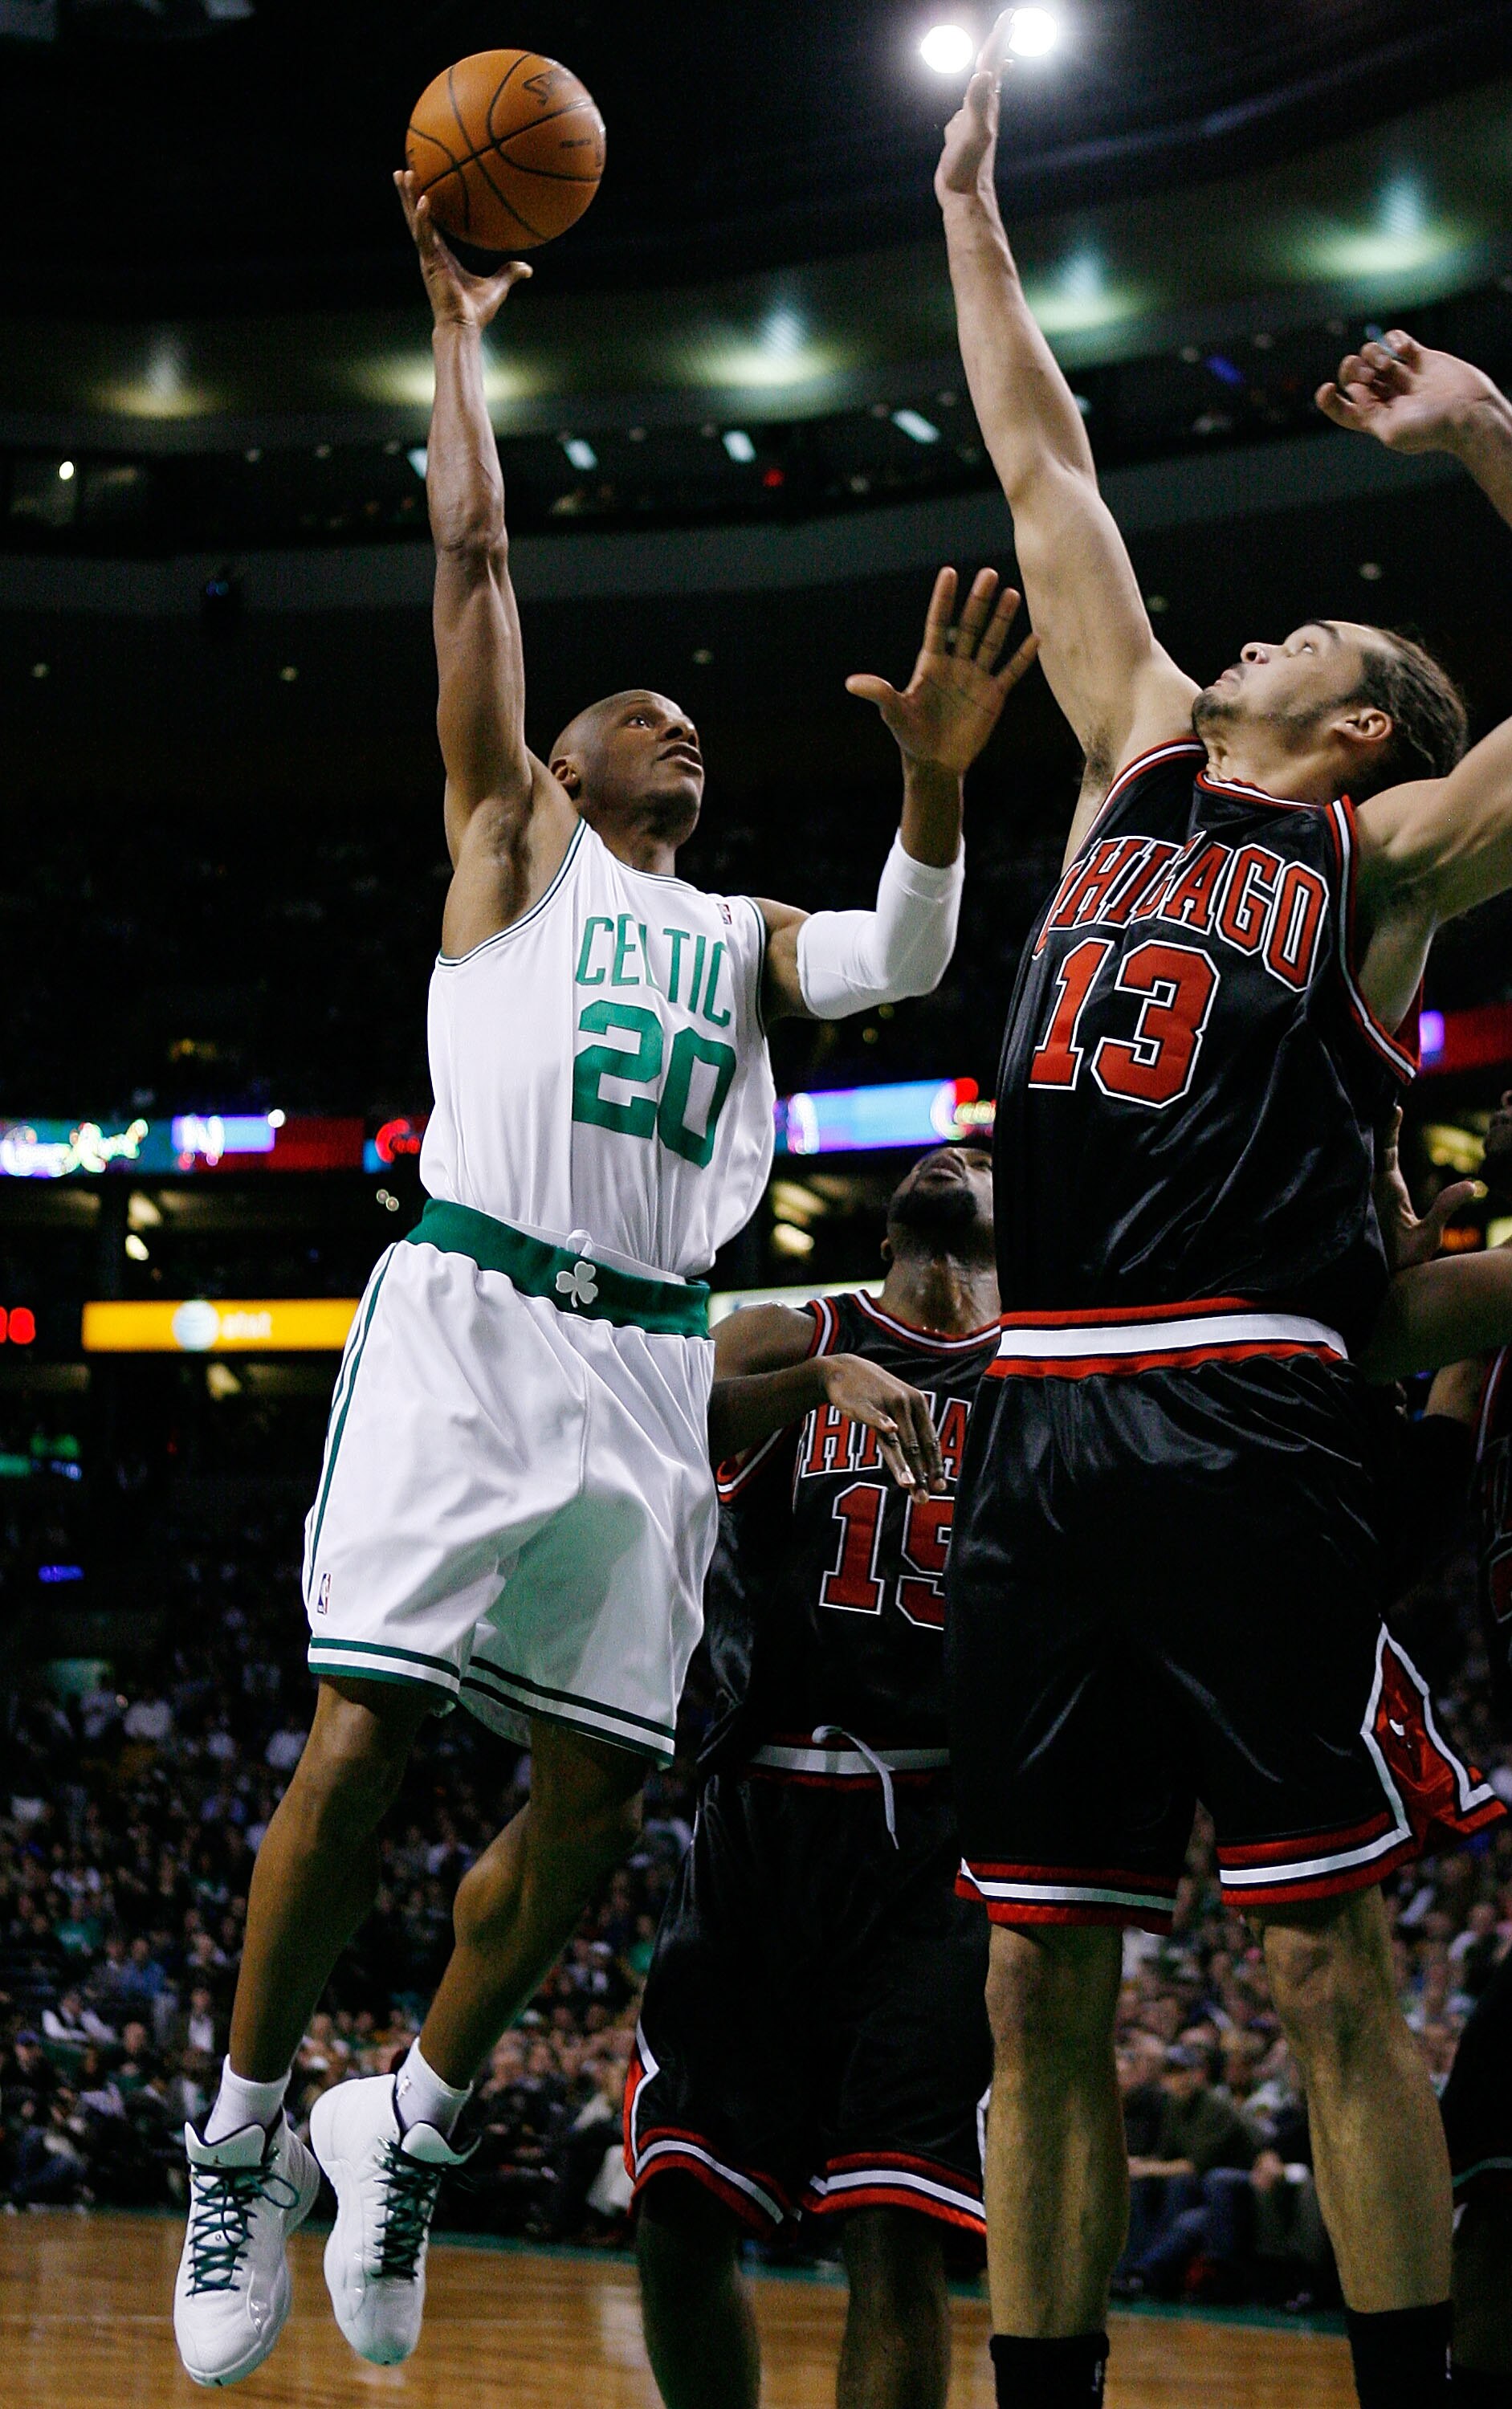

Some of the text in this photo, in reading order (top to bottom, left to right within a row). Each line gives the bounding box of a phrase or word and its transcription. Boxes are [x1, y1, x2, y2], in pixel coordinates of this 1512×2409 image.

[572, 1000, 736, 1169] 20
[1029, 937, 1221, 1109] 13
[819, 1482, 956, 1631] 15
